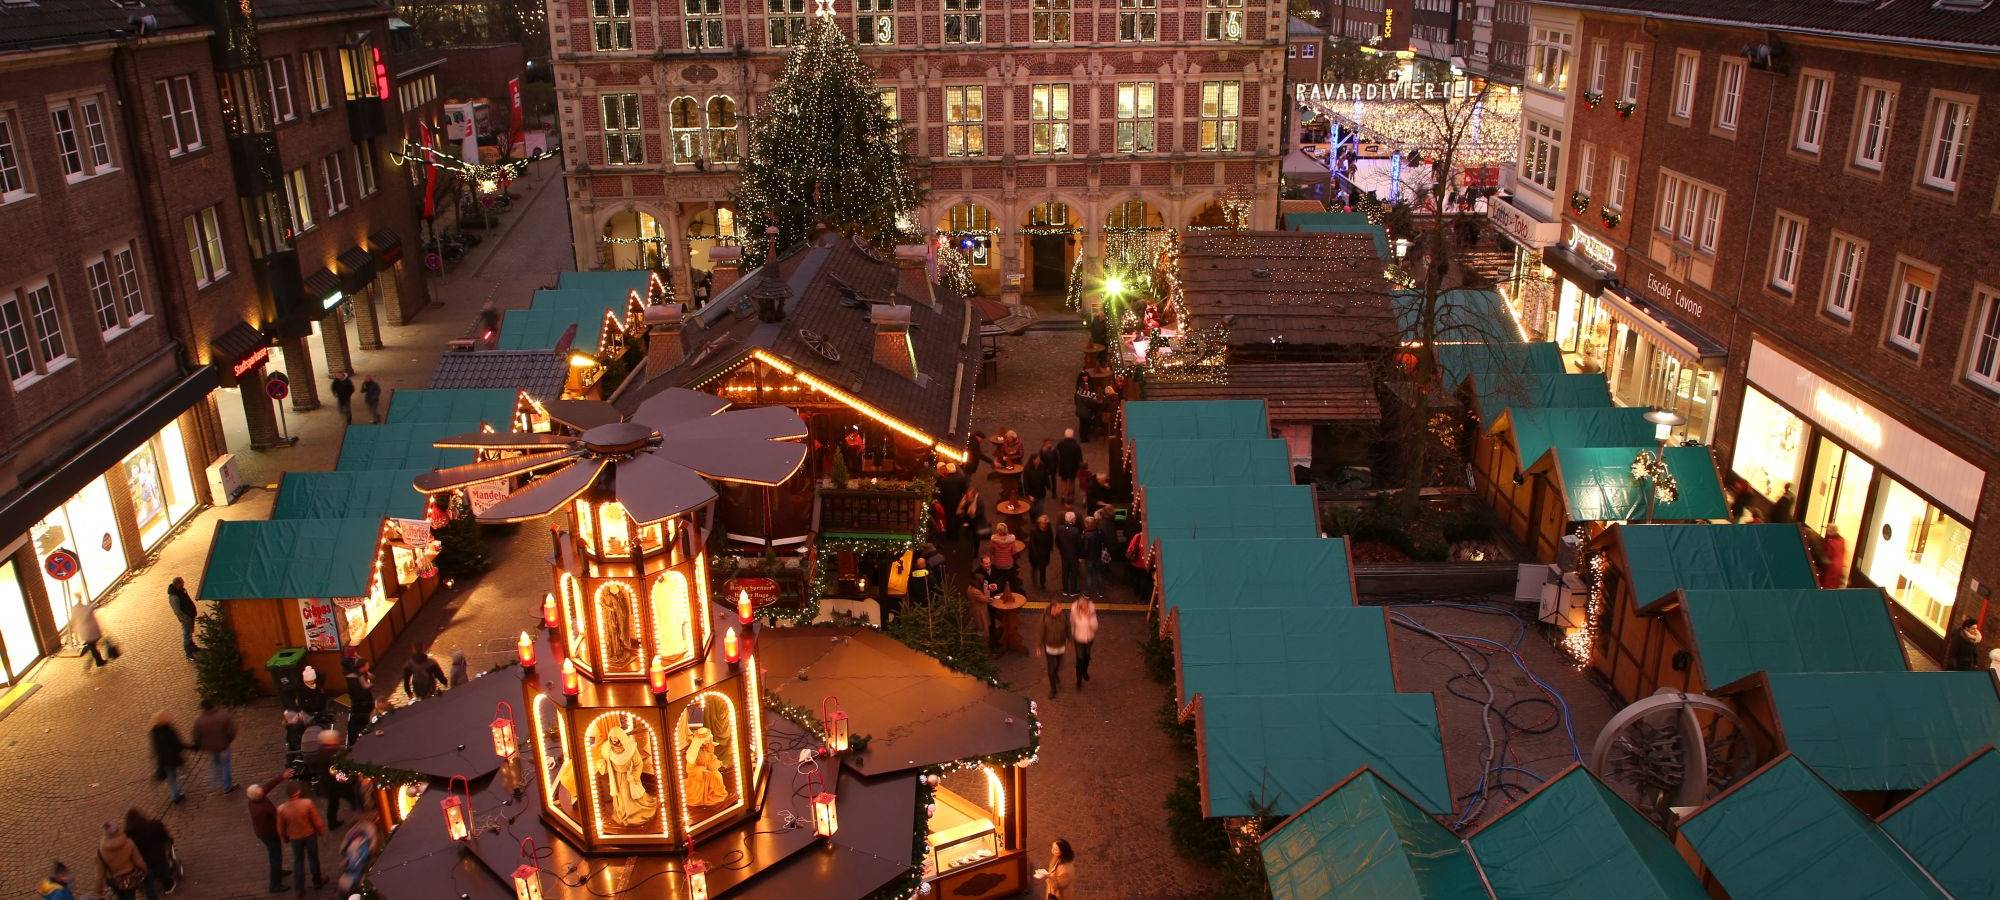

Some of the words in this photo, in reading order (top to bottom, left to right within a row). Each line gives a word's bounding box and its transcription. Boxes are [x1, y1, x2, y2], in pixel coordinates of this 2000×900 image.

[879, 16, 892, 42] 3
[1227, 11, 1240, 38] 6
[1384, 9, 1393, 38] SCHUHE
[681, 133, 691, 157] 1
[1514, 214, 1528, 238] Toto
[1647, 273, 1672, 300] Eiscafe
[1675, 289, 1702, 318] Cavone
